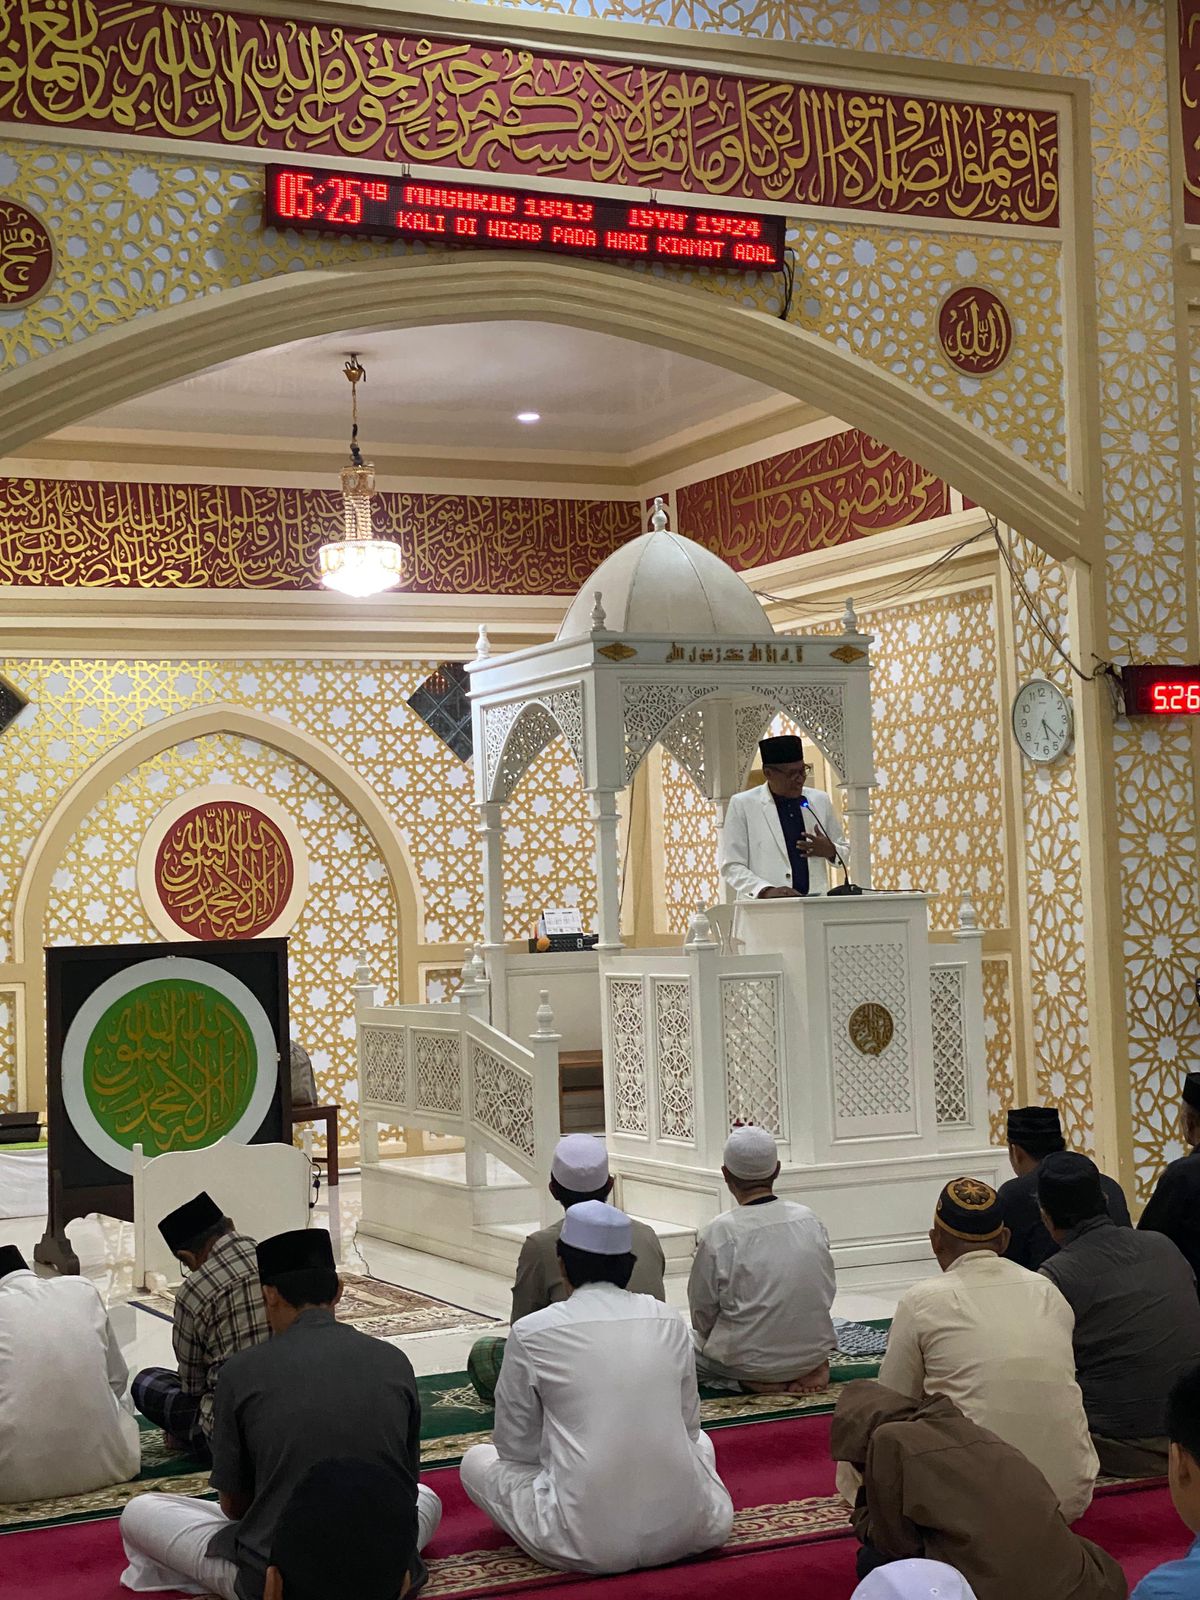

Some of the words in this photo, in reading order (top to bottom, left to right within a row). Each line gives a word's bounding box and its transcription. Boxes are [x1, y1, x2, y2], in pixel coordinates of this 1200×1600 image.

[363, 182, 388, 201] 49
[277, 173, 362, 224] 05:25
[397, 211, 446, 233] KALI
[456, 216, 478, 236] DI
[487, 220, 543, 242] HISAB
[552, 226, 598, 248] PADA
[604, 231, 649, 252] HARI
[655, 236, 726, 259] KIAMAT
[733, 244, 777, 264] ADAL
[1029, 691, 1036, 701] 11
[1037, 687, 1046, 698] 12
[1022, 704, 1031, 714] 10
[1056, 700, 1063, 710] 2
[1021, 718, 1028, 728] 9
[1061, 714, 1067, 725] 3
[1025, 732, 1032, 742] 8
[1058, 729, 1065, 738] 4
[1033, 742, 1040, 752] 7
[1042, 745, 1050, 755] 6
[1052, 741, 1059, 751] 5
